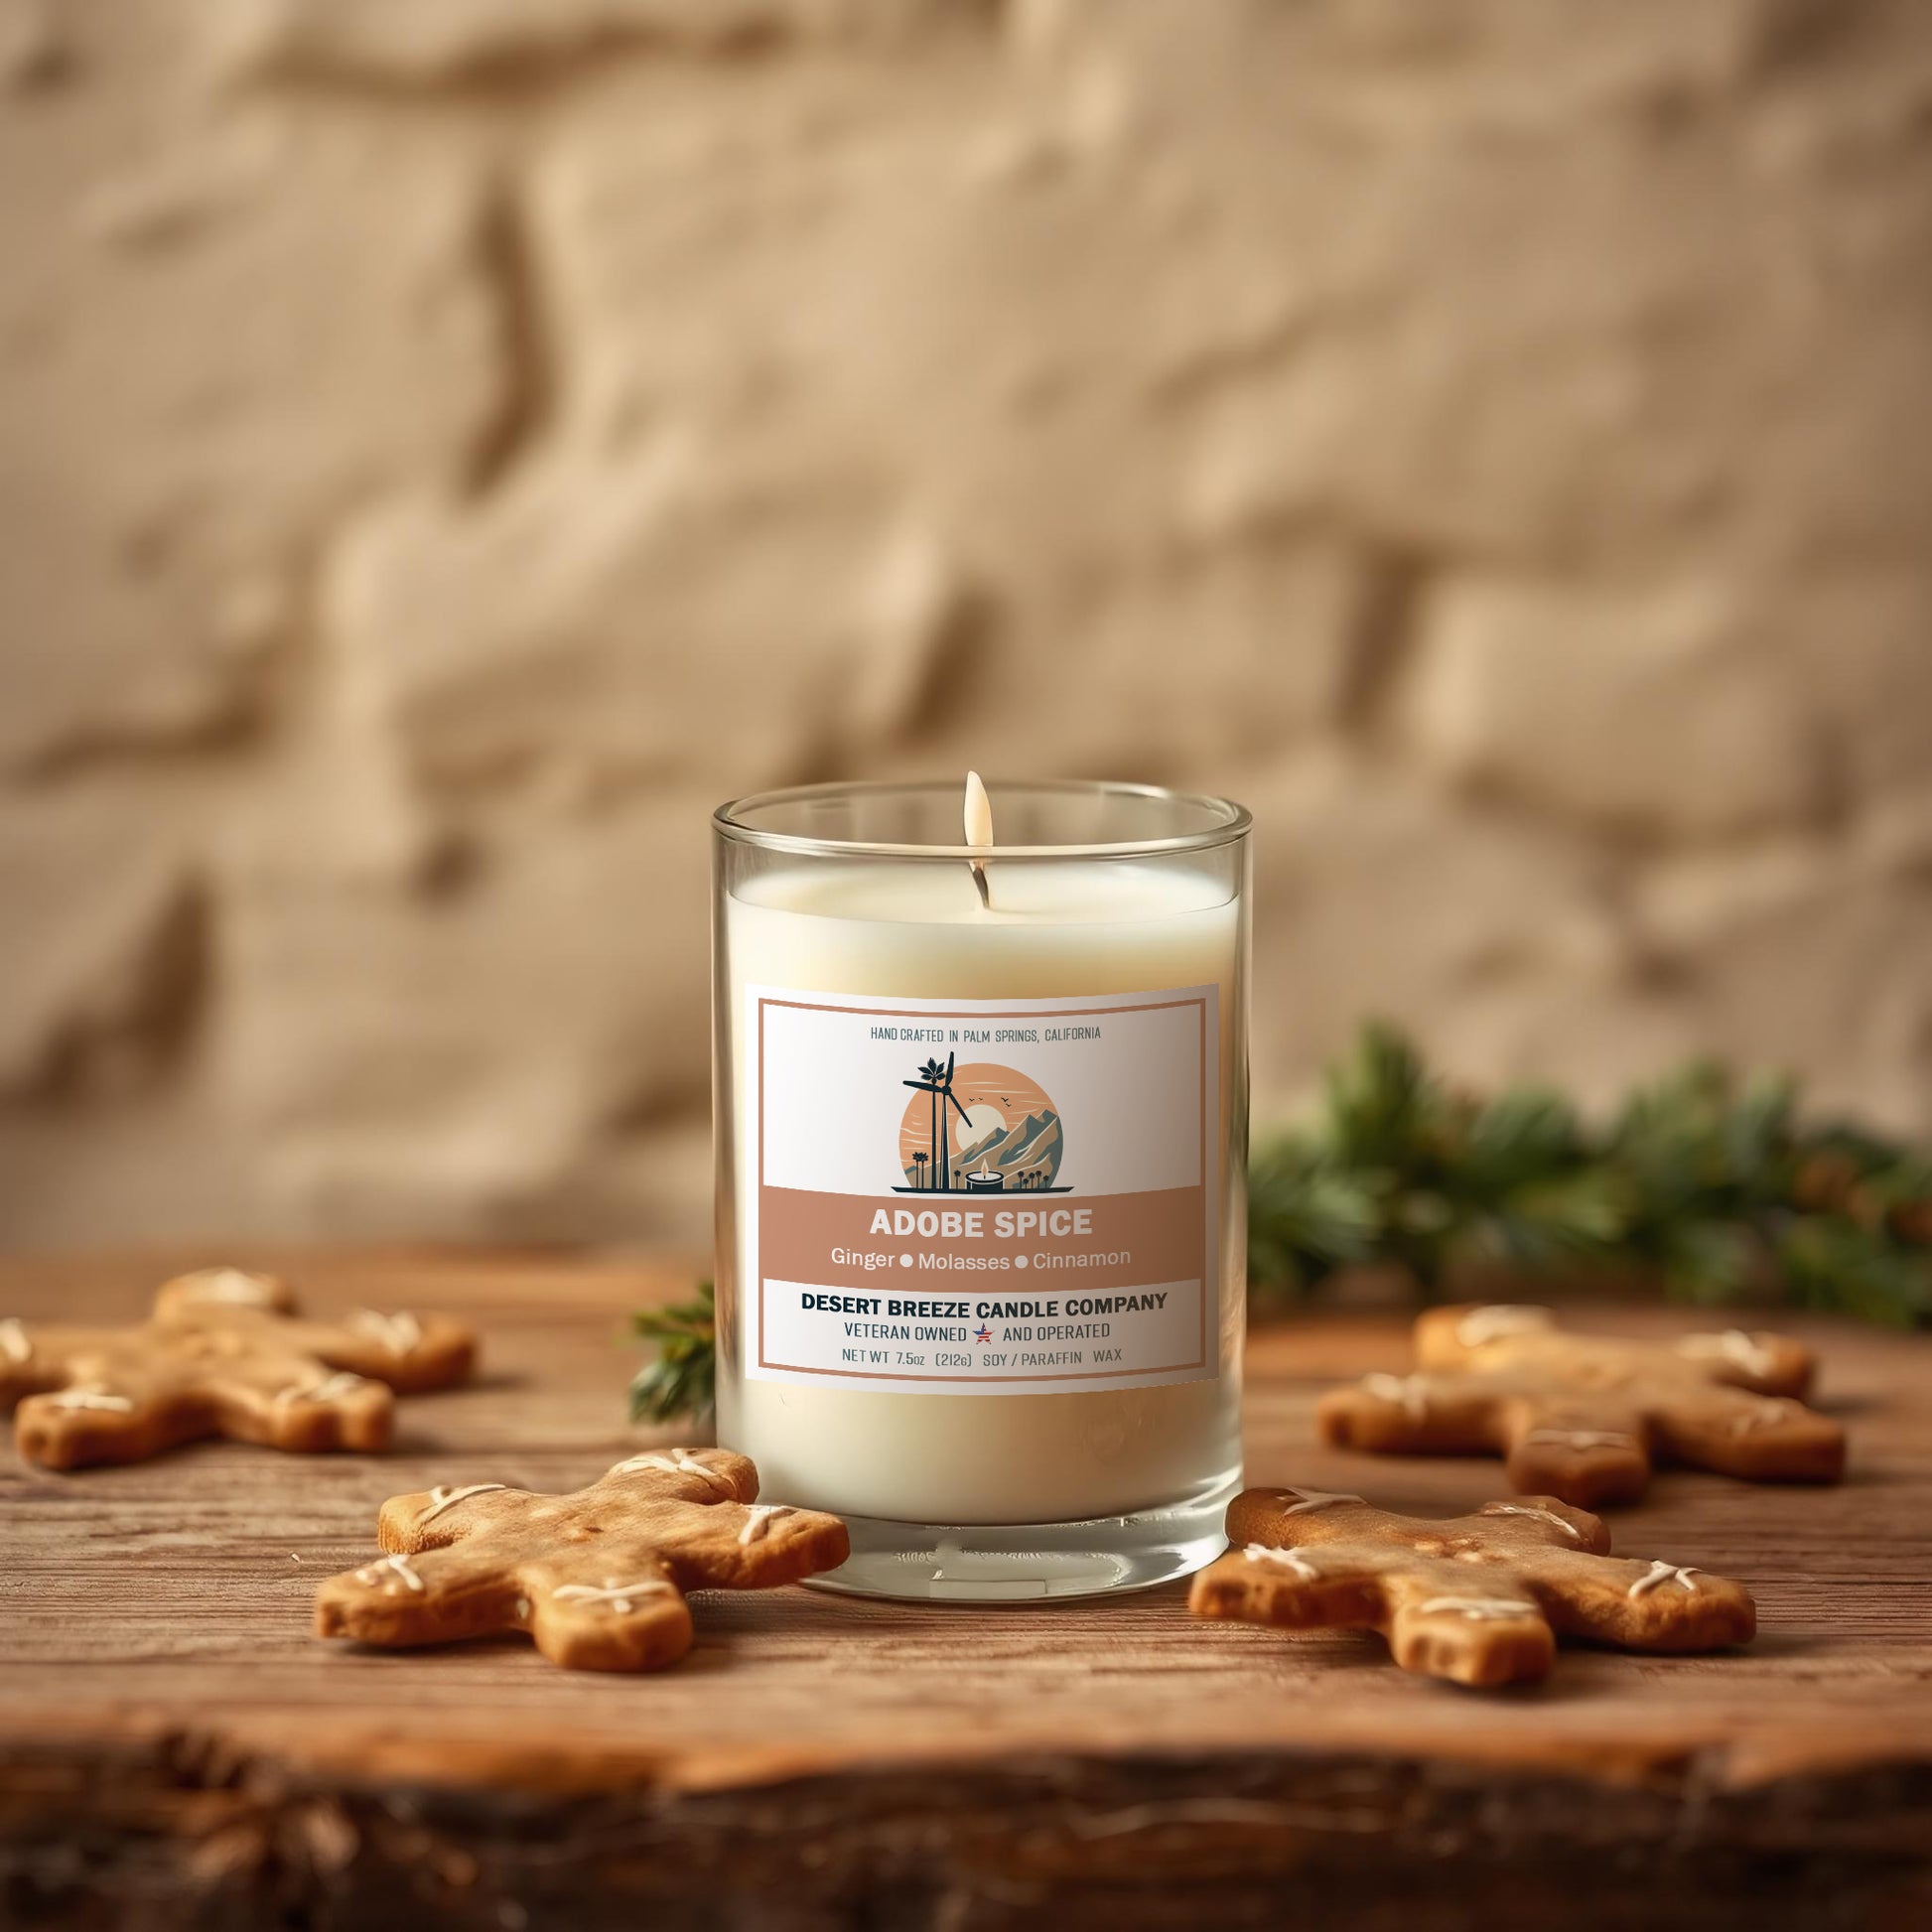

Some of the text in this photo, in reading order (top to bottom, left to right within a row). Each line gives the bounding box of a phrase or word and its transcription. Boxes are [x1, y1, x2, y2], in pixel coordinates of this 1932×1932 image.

[871, 1027, 1102, 1043] HAND CRAFTED IN PALM SPRINGS, CALIFORNIA
[870, 1208, 1093, 1238] ADOBE SPICE
[831, 1247, 1131, 1272] Ginger Molasses Cinnamon
[801, 1292, 1169, 1319] DESERT BREEZE CANDLE COMPANY
[844, 1322, 1110, 1342] VETERAN OWNED AND OPERATED
[842, 1348, 866, 1363] NET
[869, 1350, 890, 1365] WT
[983, 1353, 1007, 1367] SOY
[1021, 1350, 1082, 1366] PARAFFIN
[1093, 1349, 1123, 1363] WAX
